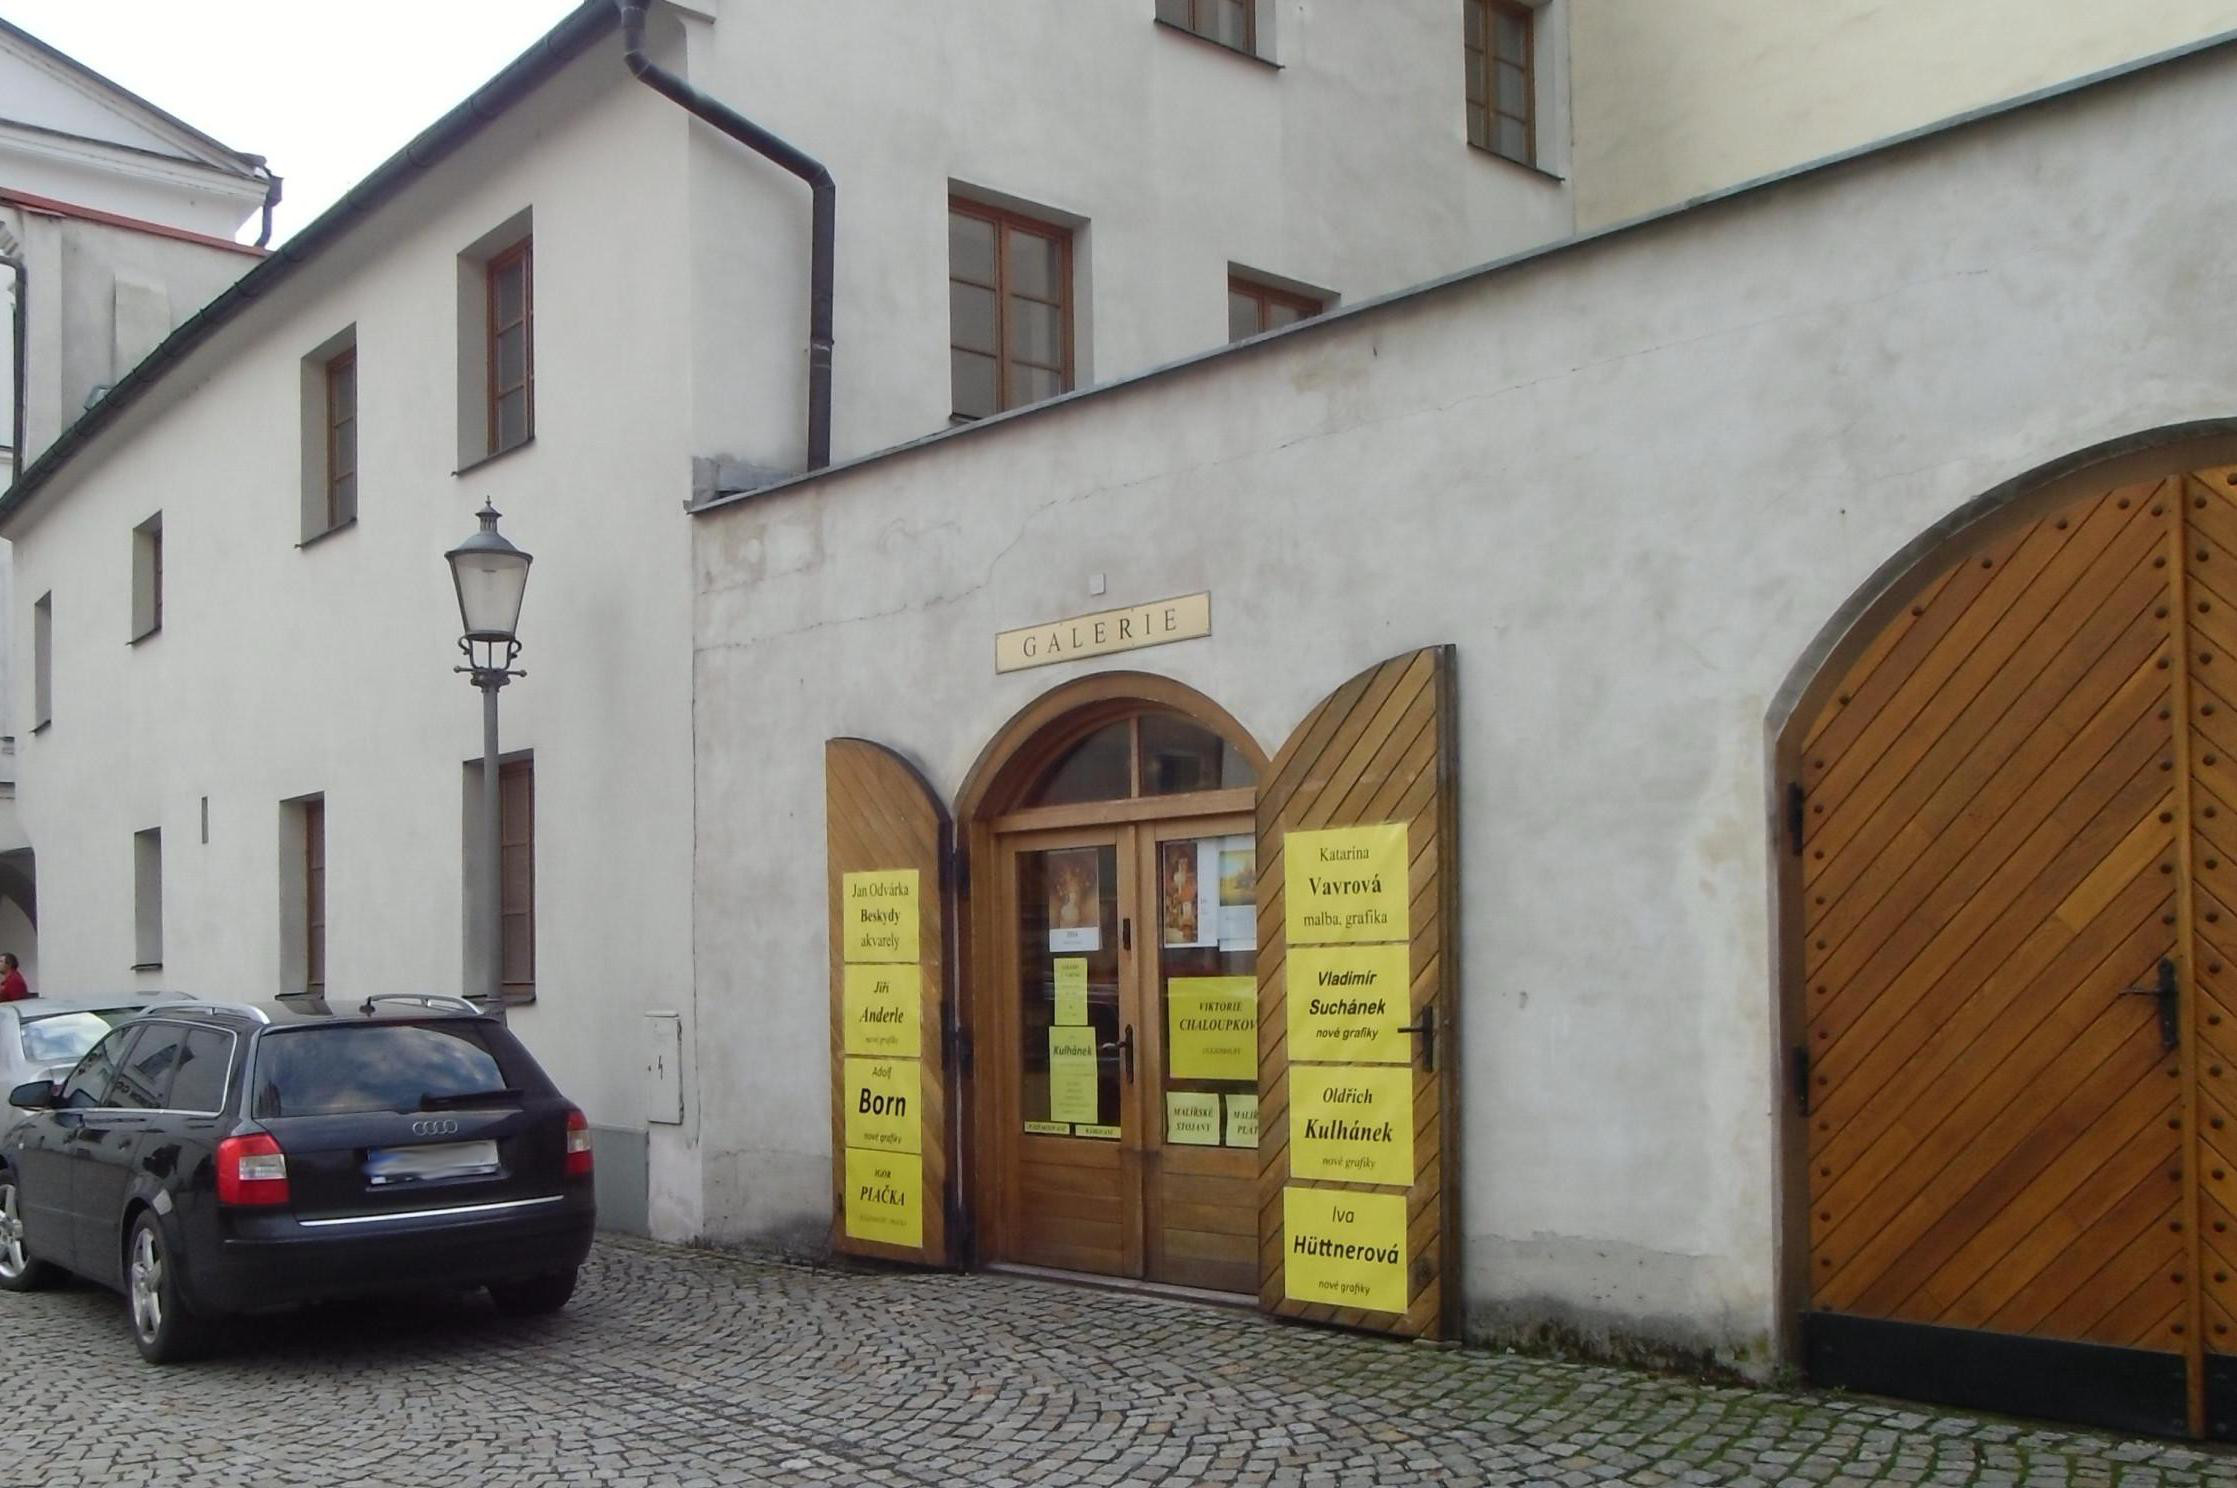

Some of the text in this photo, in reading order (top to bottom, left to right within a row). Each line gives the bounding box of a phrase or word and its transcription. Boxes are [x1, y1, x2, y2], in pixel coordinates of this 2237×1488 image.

[1022, 608, 1177, 657] GALERIE
[852, 881, 909, 898] Jan Odvárka
[1309, 873, 1383, 896] Vavrová
[860, 907, 901, 926] Beskydy
[1345, 909, 1388, 929] grafika
[860, 931, 900, 951] akvarely
[1318, 970, 1378, 987] Vladimír
[859, 1006, 904, 1024] Anderle
[1199, 1001, 1243, 1013] VIKTORIE
[1309, 997, 1386, 1015] Suchánek
[1315, 1027, 1379, 1041] nové grafiky
[1053, 1044, 1093, 1057] Kulhánek
[872, 1065, 893, 1080] Adolf
[858, 1087, 907, 1118] Born
[1322, 1087, 1374, 1104] Oldřich
[1304, 1118, 1393, 1143] Kulhánek
[1321, 1155, 1377, 1170] nové grafiky
[1332, 1205, 1356, 1224] Iva
[1293, 1234, 1400, 1265] Hüttnerová
[1318, 1279, 1372, 1296] nové grafiky
